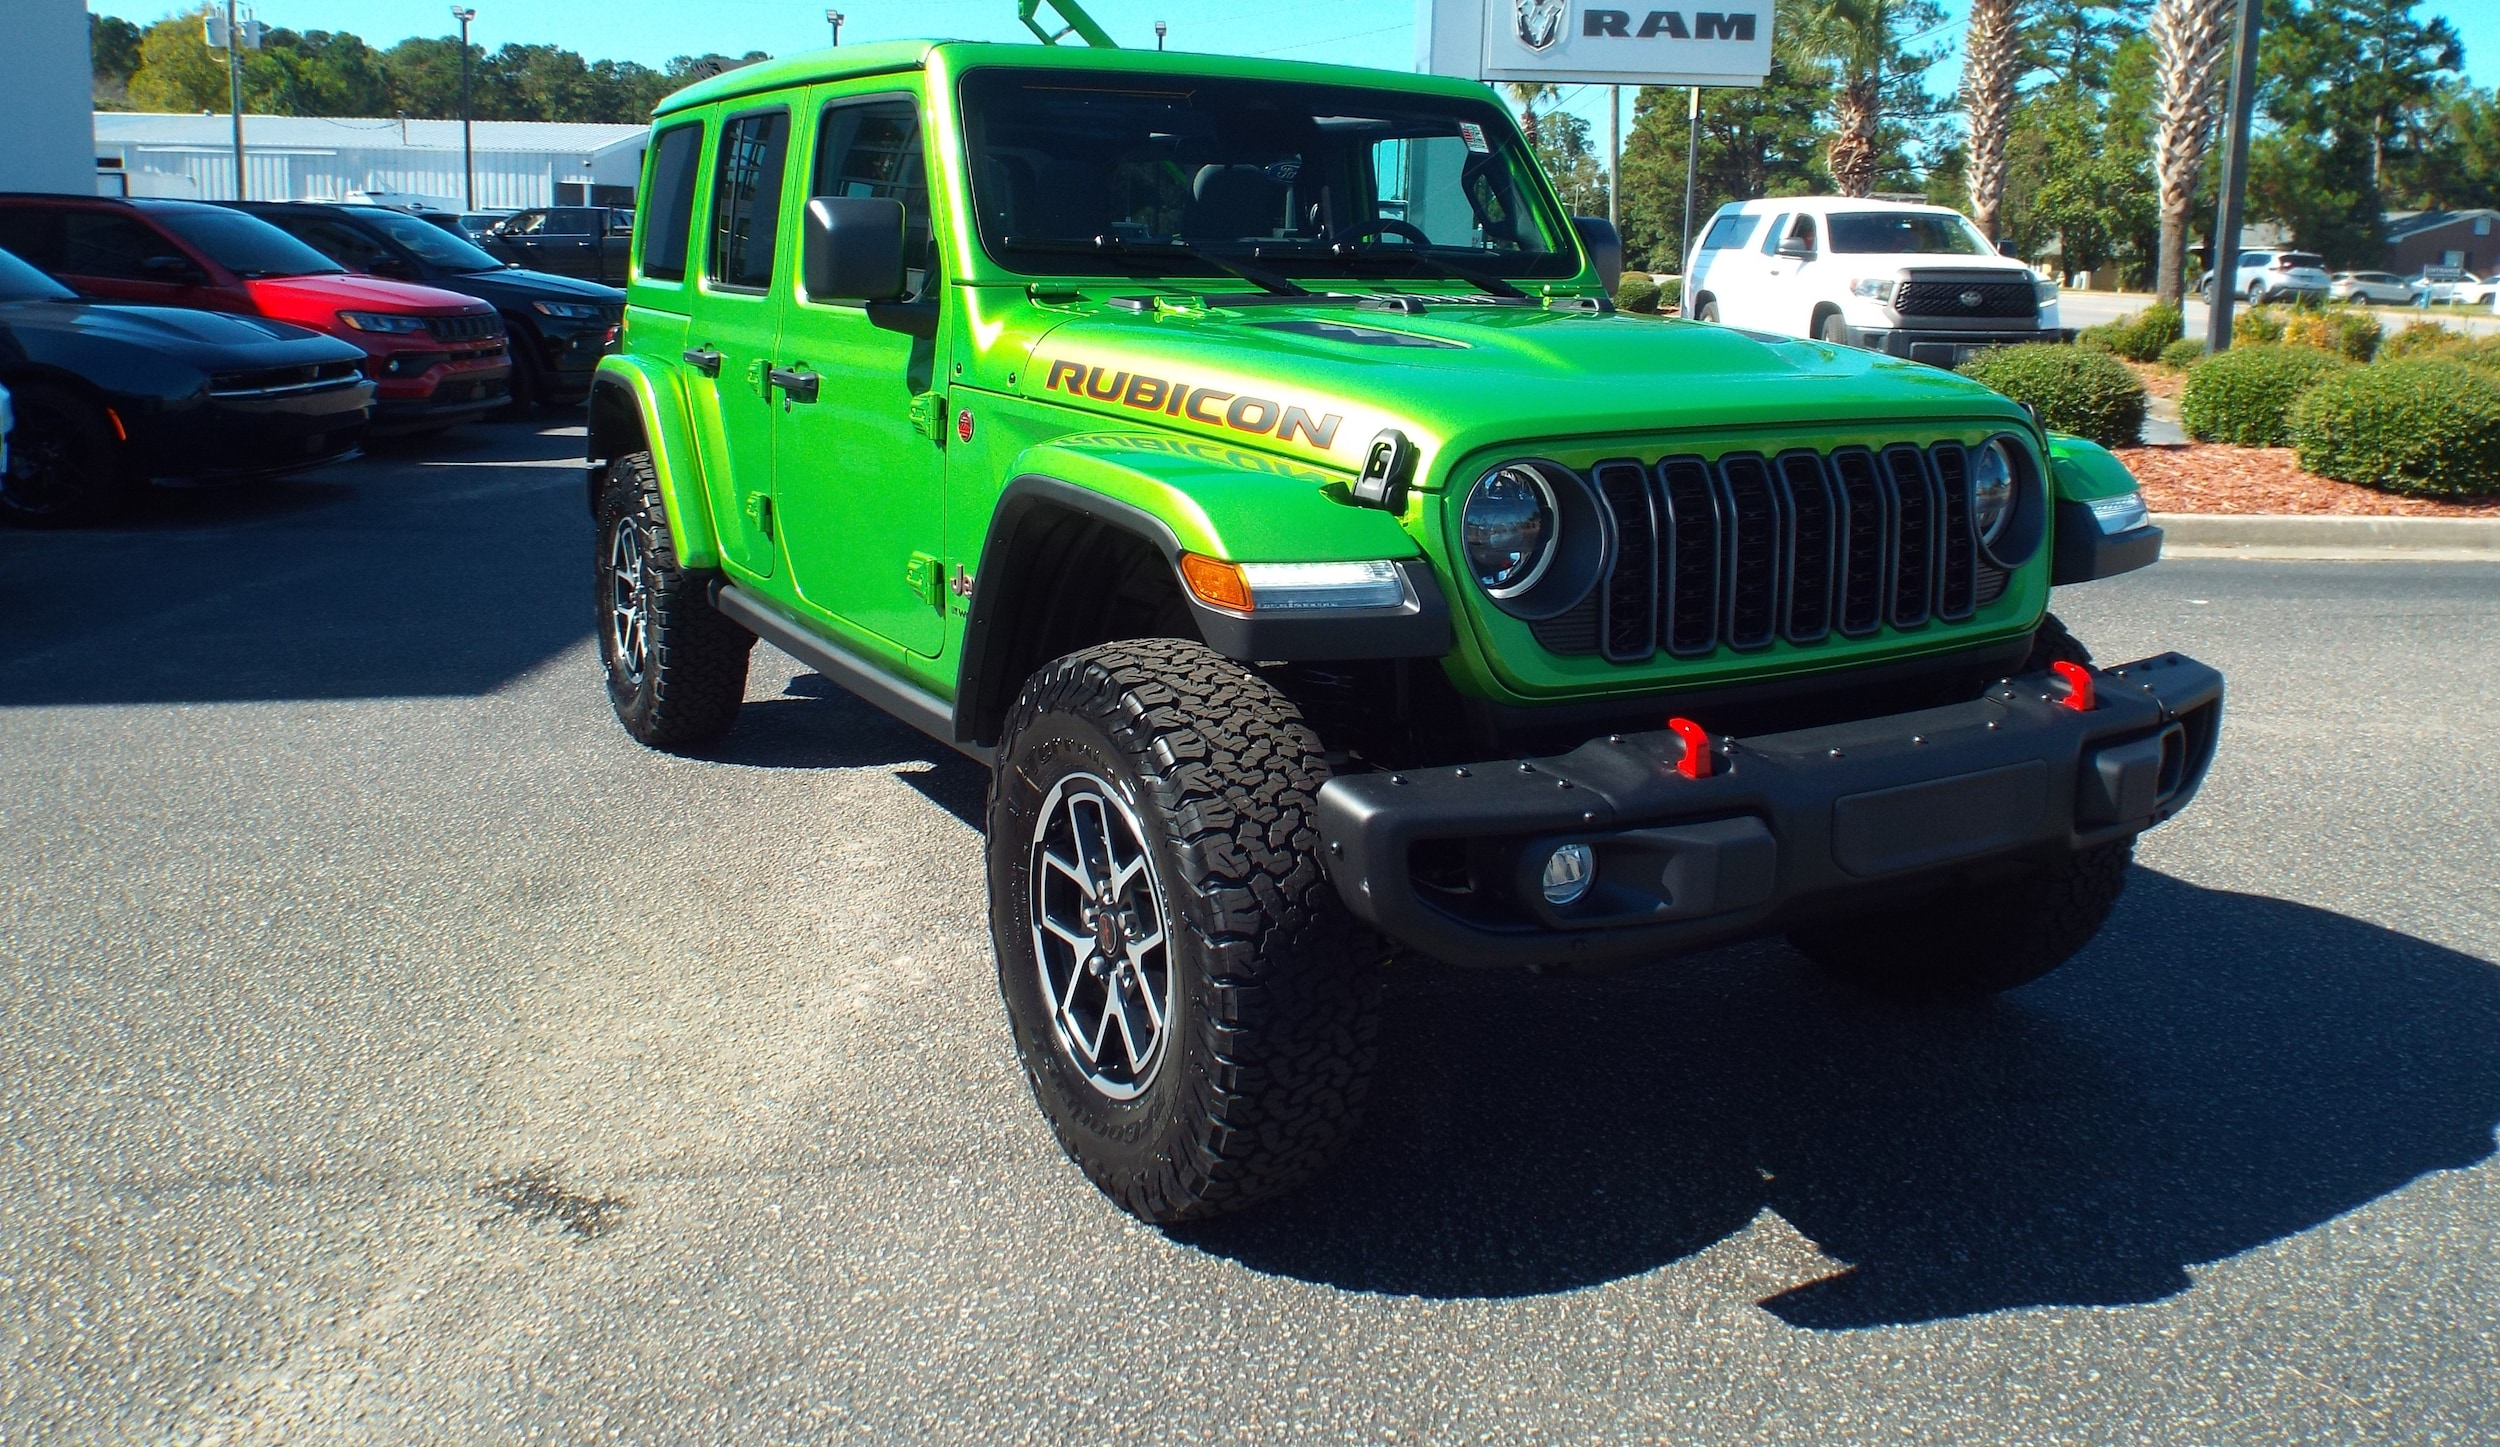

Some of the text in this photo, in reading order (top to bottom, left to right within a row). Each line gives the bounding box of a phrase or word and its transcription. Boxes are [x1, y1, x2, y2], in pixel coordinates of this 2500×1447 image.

[1584, 10, 1756, 41] RAM
[1277, 164, 1301, 179] Fo
[1047, 360, 1342, 449] RUBICON
[950, 563, 973, 597] Je
